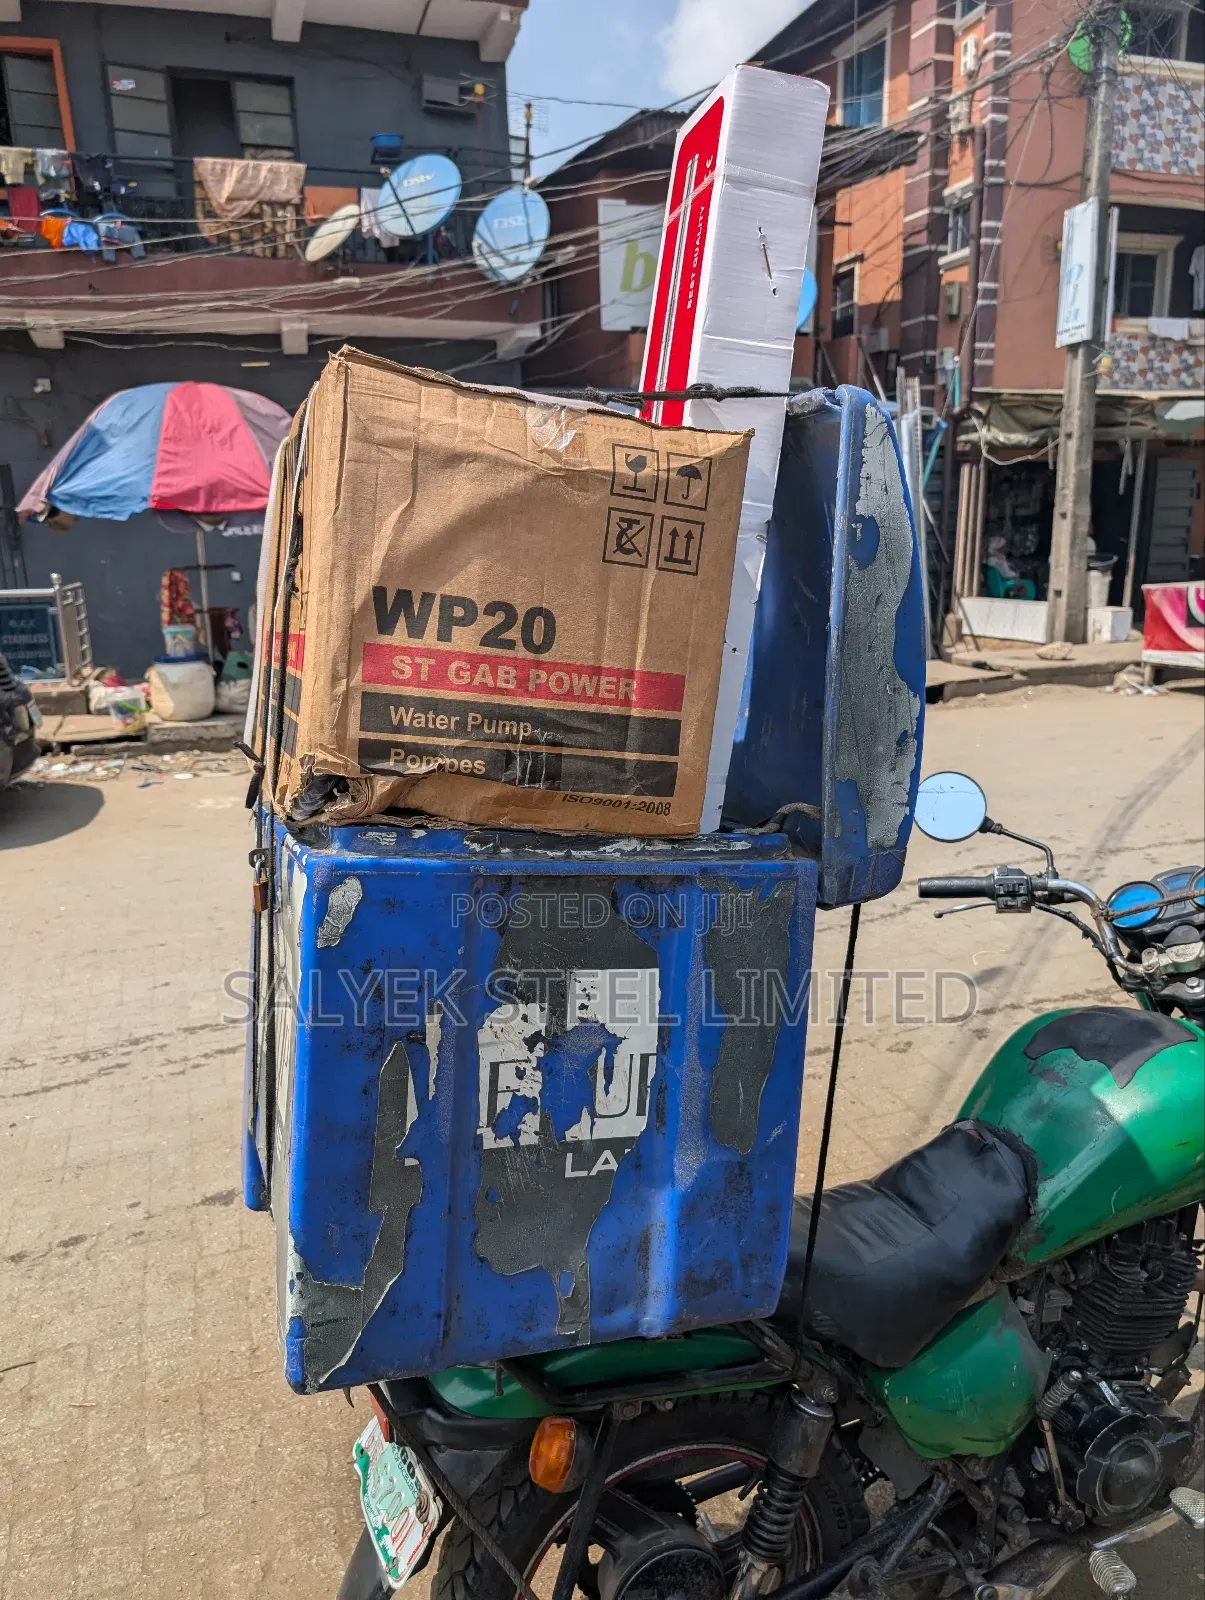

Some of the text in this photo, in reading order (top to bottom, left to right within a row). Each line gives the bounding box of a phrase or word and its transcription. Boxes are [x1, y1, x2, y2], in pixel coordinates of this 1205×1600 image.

[686, 205, 705, 310] BEST QUALITY
[371, 585, 557, 655] WP20
[391, 654, 638, 702] ST GAB POWER
[389, 704, 533, 739] Water Pump
[388, 747, 486, 776] Pompes
[561, 793, 672, 817] ISO9001:2008
[564, 1148, 632, 1178] LA
